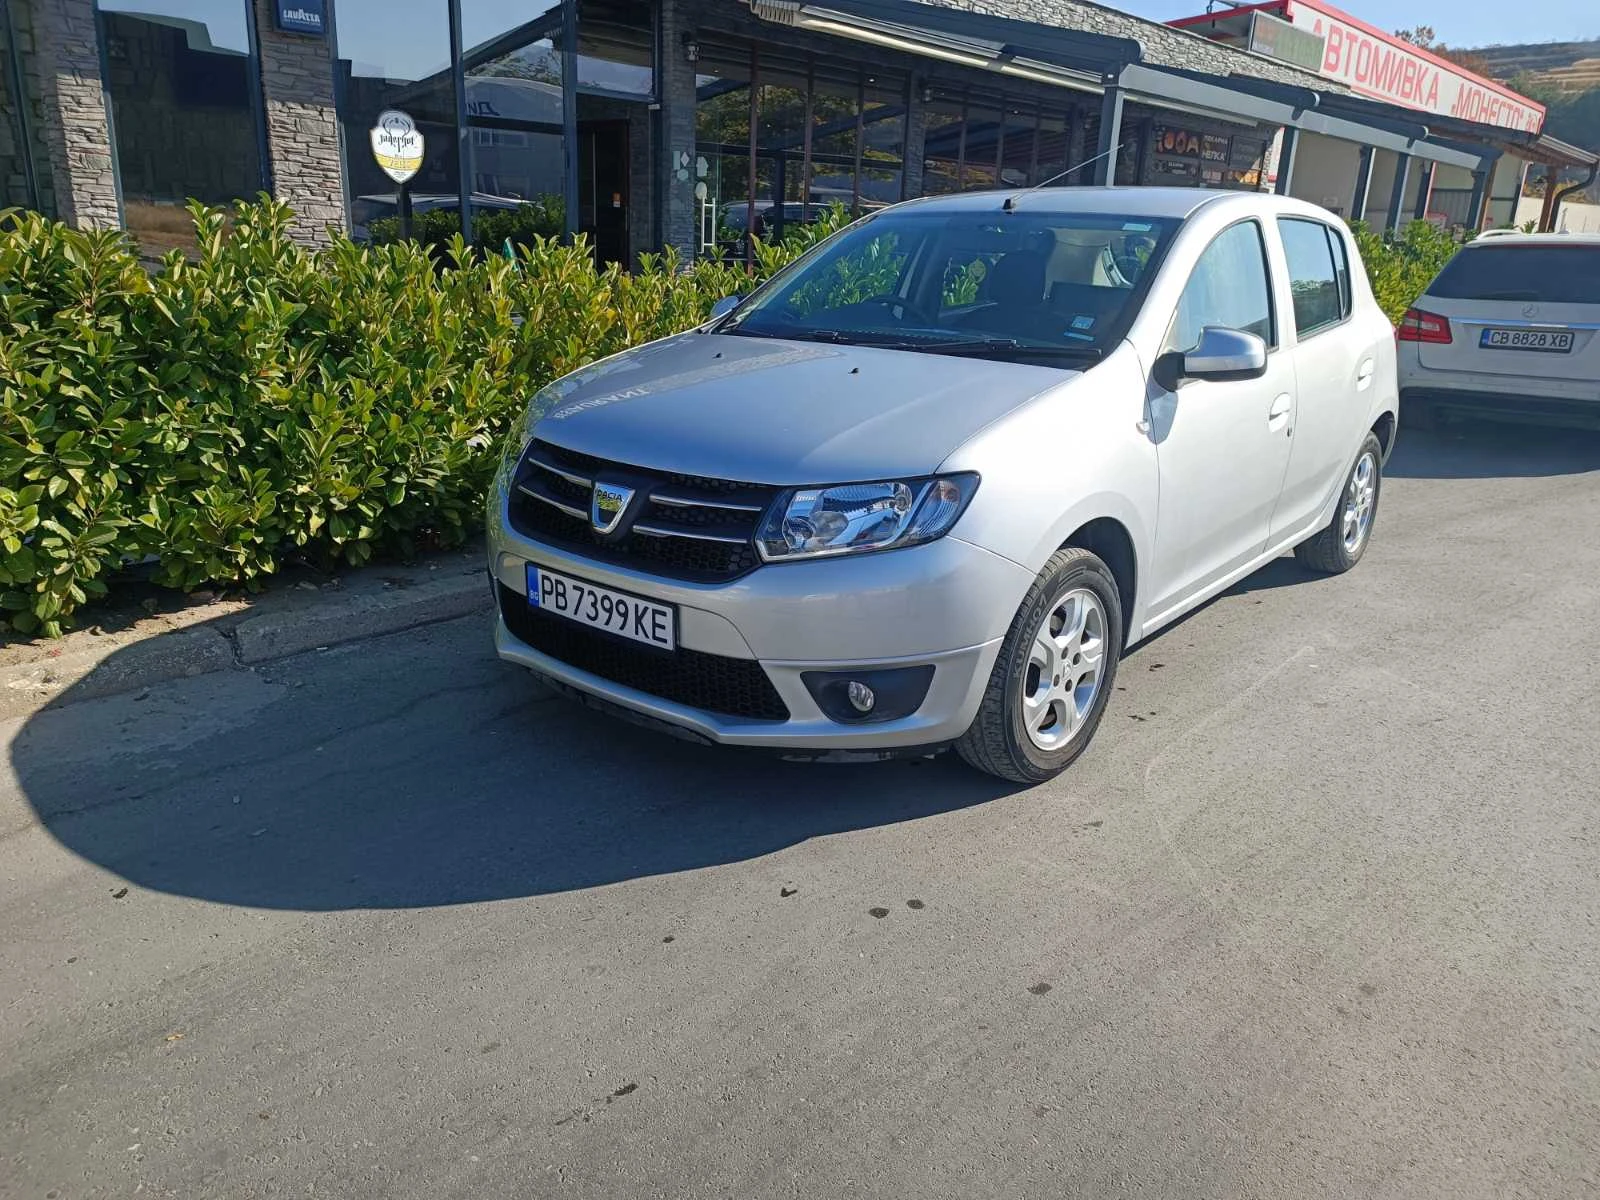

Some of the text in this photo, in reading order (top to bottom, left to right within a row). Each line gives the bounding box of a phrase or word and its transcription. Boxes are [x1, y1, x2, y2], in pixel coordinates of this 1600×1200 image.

[283, 8, 321, 22] LAVAZZA
[1491, 331, 1568, 347] CB 8828 XB
[597, 489, 622, 501] DACIA
[541, 574, 668, 644] PB 7399 KE
